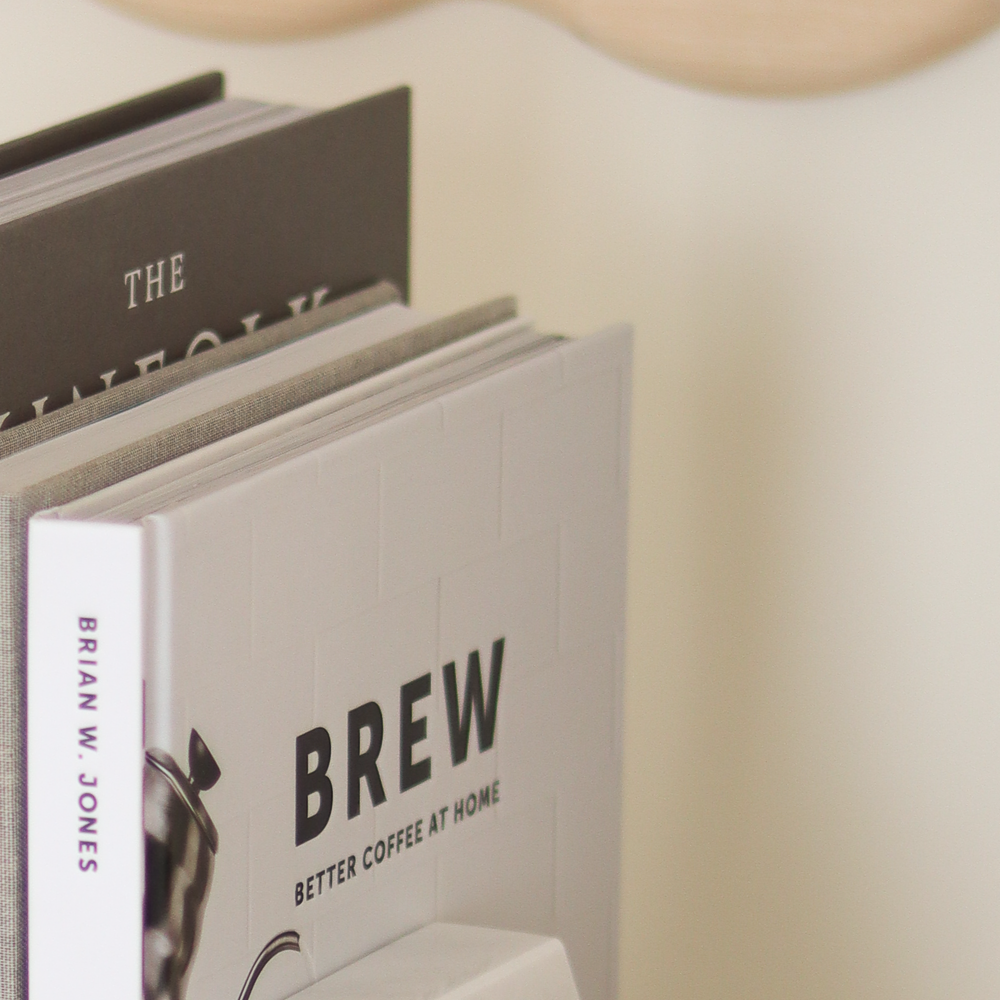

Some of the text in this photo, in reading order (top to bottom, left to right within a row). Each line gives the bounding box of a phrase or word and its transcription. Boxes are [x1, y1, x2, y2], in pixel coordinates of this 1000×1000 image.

[124, 254, 184, 309] THE
[77, 616, 98, 873] BRIAN W. JONES
[295, 636, 506, 848] BREW
[294, 779, 500, 907] BETTER COFFEE AT HOME
